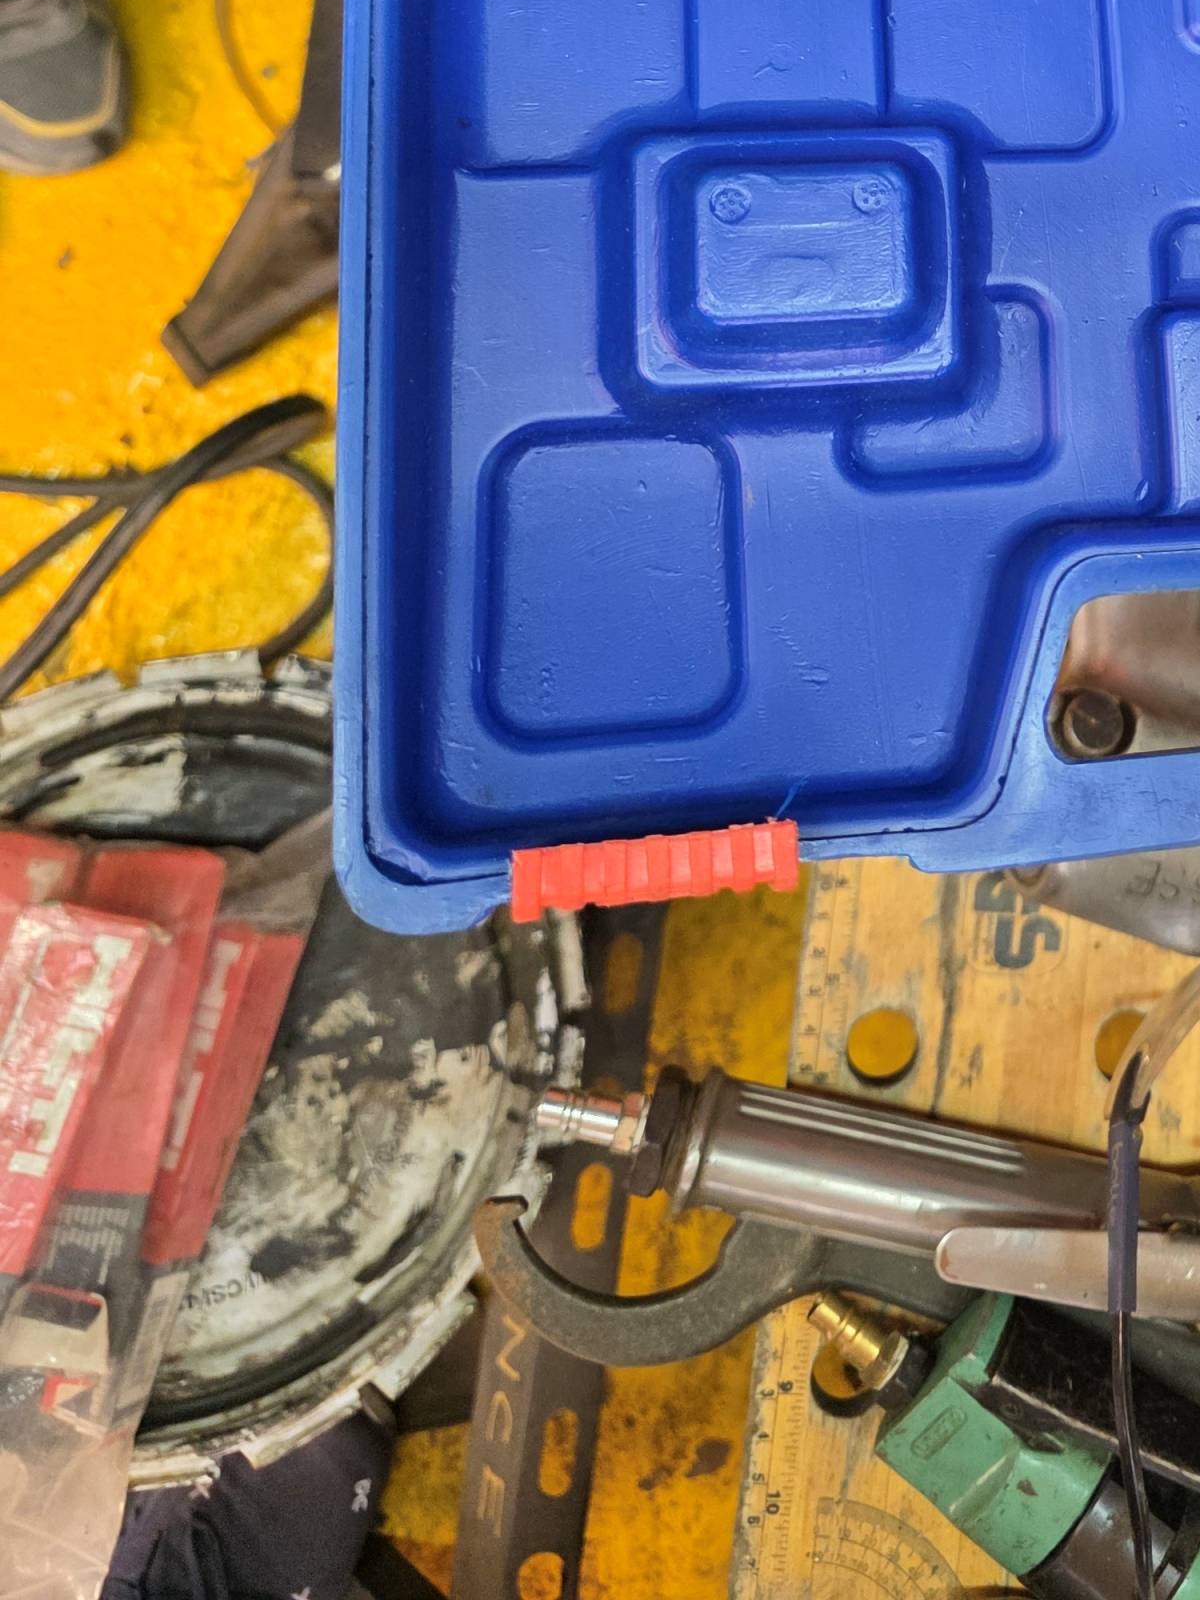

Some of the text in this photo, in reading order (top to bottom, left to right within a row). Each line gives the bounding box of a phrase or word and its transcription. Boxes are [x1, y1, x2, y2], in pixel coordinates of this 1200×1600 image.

[8, 934, 133, 1177] HILTI
[766, 1379, 793, 1515] 9 10
